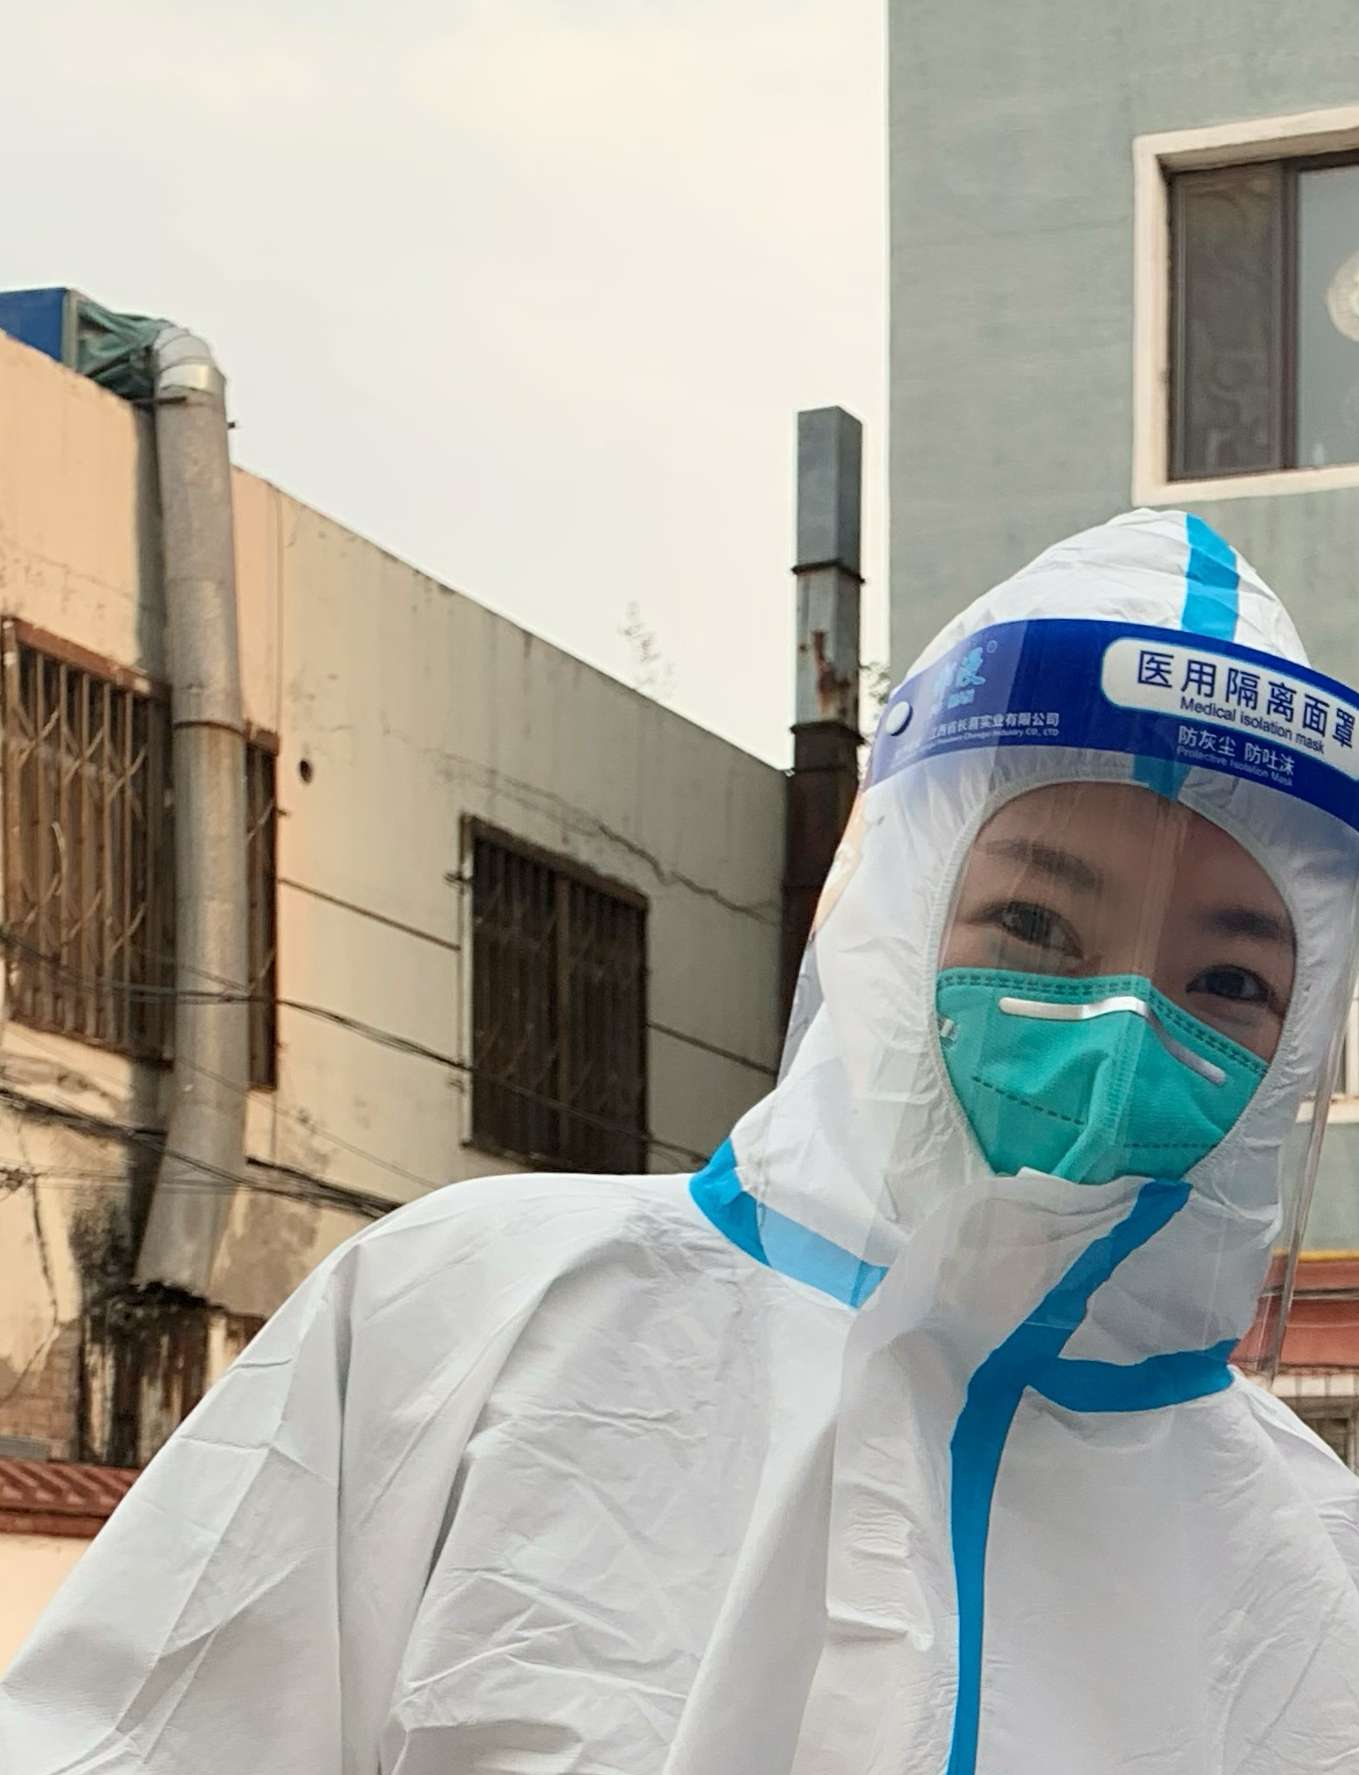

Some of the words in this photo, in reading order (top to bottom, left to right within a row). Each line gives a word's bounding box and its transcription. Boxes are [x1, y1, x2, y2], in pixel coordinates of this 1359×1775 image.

[1137, 650, 1356, 749] 医用隔离面罩
[1180, 697, 1237, 722] Medical
[1240, 711, 1292, 741] isolation
[1295, 731, 1325, 755] mask
[1178, 725, 1237, 757] 防灰尘
[1244, 741, 1296, 777] 防吐沫
